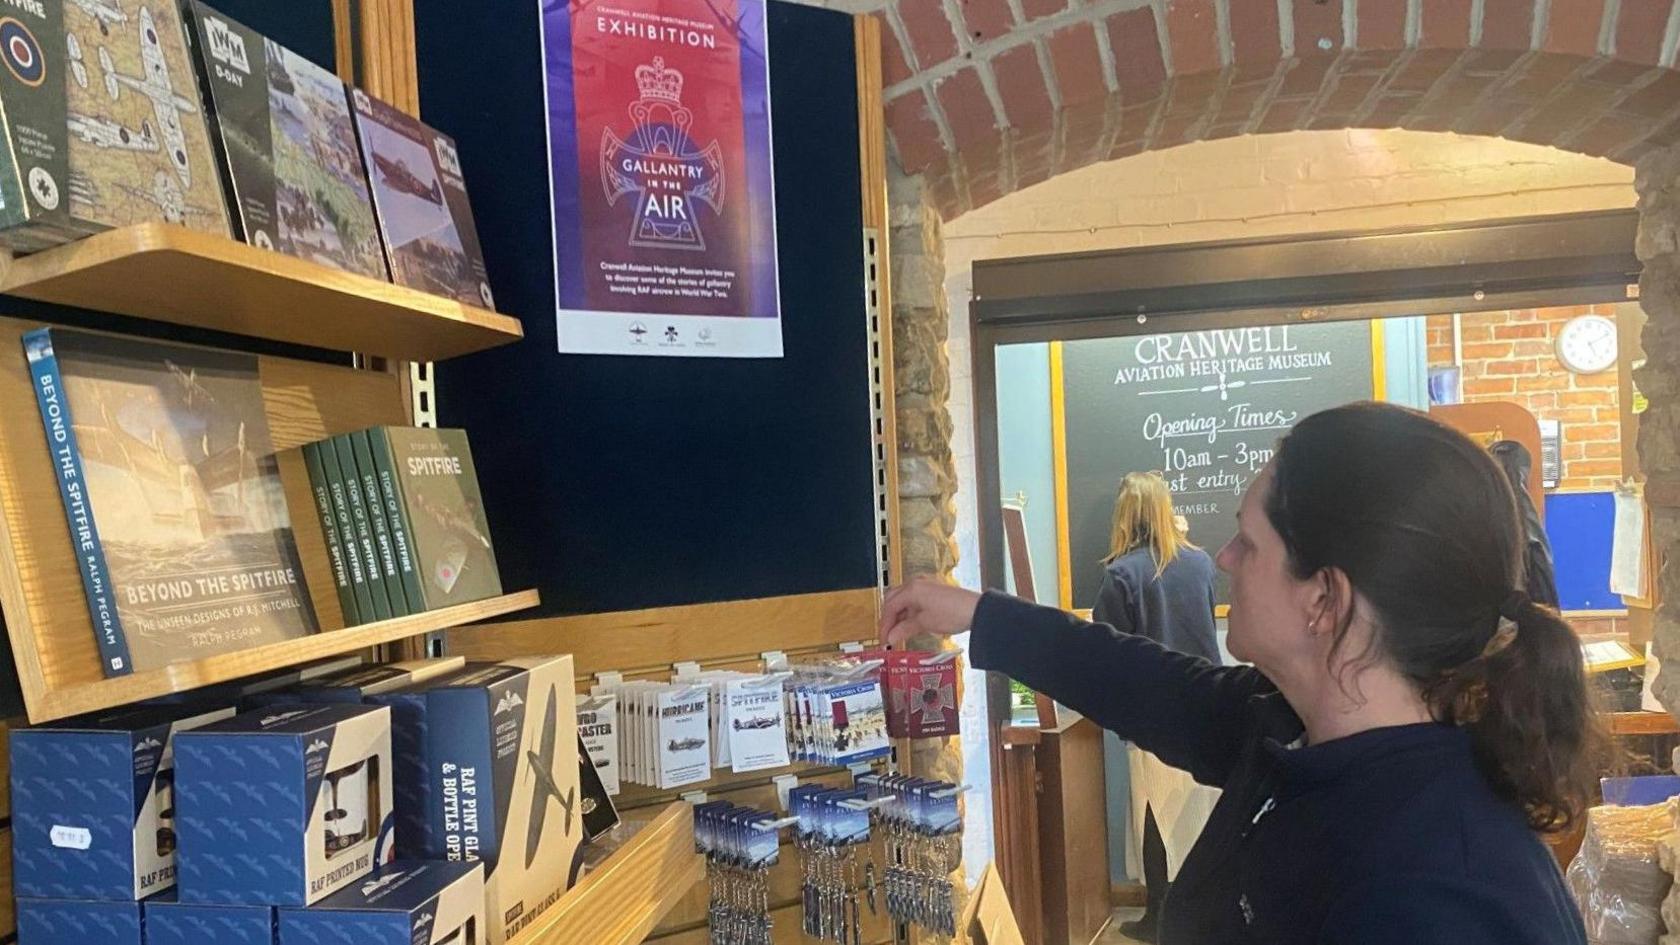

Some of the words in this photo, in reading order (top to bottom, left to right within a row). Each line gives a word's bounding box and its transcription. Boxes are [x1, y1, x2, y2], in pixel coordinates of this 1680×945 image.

[597, 17, 715, 48] EXHIBITION
[215, 64, 243, 87] D-DAY
[622, 158, 703, 179] GALLANTRY
[647, 179, 658, 188] IN
[662, 180, 681, 190] THE
[644, 193, 687, 220] AIR
[600, 262, 627, 270] Cranwell
[628, 264, 652, 272] Aviation
[680, 267, 703, 275] Museum
[638, 285, 650, 294] RAF
[1135, 325, 1298, 364] CRANWELL
[1114, 364, 1185, 385] AVIATION
[1191, 357, 1264, 375] HERITAGE
[1268, 351, 1332, 370] MUSEUM
[1143, 412, 1227, 449] Opening
[1228, 403, 1297, 428] Times
[408, 456, 462, 476] SPITFIRE
[1164, 446, 1212, 472] 10am
[1234, 442, 1274, 471] 3pm
[348, 479, 360, 506] STORY
[365, 474, 377, 502] STORY
[381, 471, 394, 498] STORY
[1197, 469, 1247, 496] entry
[40, 374, 67, 443] BEYOND
[58, 444, 76, 480] THE
[67, 482, 95, 551] SPITFIRE
[87, 555, 103, 594] RALPH
[97, 597, 116, 645] PEGRAM
[316, 486, 329, 514] STORY
[332, 483, 345, 511] STORY
[372, 503, 381, 515] OF
[388, 500, 398, 511] OF
[324, 515, 333, 527] OF
[340, 511, 348, 523] OF
[355, 507, 364, 519] OF
[376, 517, 385, 533] THE
[392, 513, 402, 529] THE
[328, 528, 337, 545] THE
[344, 525, 353, 541] THE
[358, 521, 368, 537] THE
[347, 542, 363, 584] SPITFIRE
[363, 538, 379, 580] SPITFIRE
[379, 534, 395, 576] SPITFIRE
[395, 530, 412, 572] SPITFIRE
[331, 546, 347, 587] SPITFIRE
[126, 580, 193, 604] BEYOND
[196, 576, 229, 595] THE
[231, 568, 296, 591] SPITFIRE
[157, 615, 193, 630] UNSEEN
[194, 609, 231, 624] DESIGNS
[232, 607, 244, 617] OF
[262, 599, 300, 613] MITCHELL
[442, 762, 457, 775] &
[461, 767, 476, 796] RAF
[443, 777, 460, 833] BOTTLE
[463, 799, 479, 832] PINT
[446, 835, 462, 862] OPE
[464, 835, 480, 863] GLA
[140, 871, 158, 890] RAF
[311, 876, 325, 894] RAF
[326, 862, 355, 888] PRINTED
[355, 854, 370, 870] MUG
